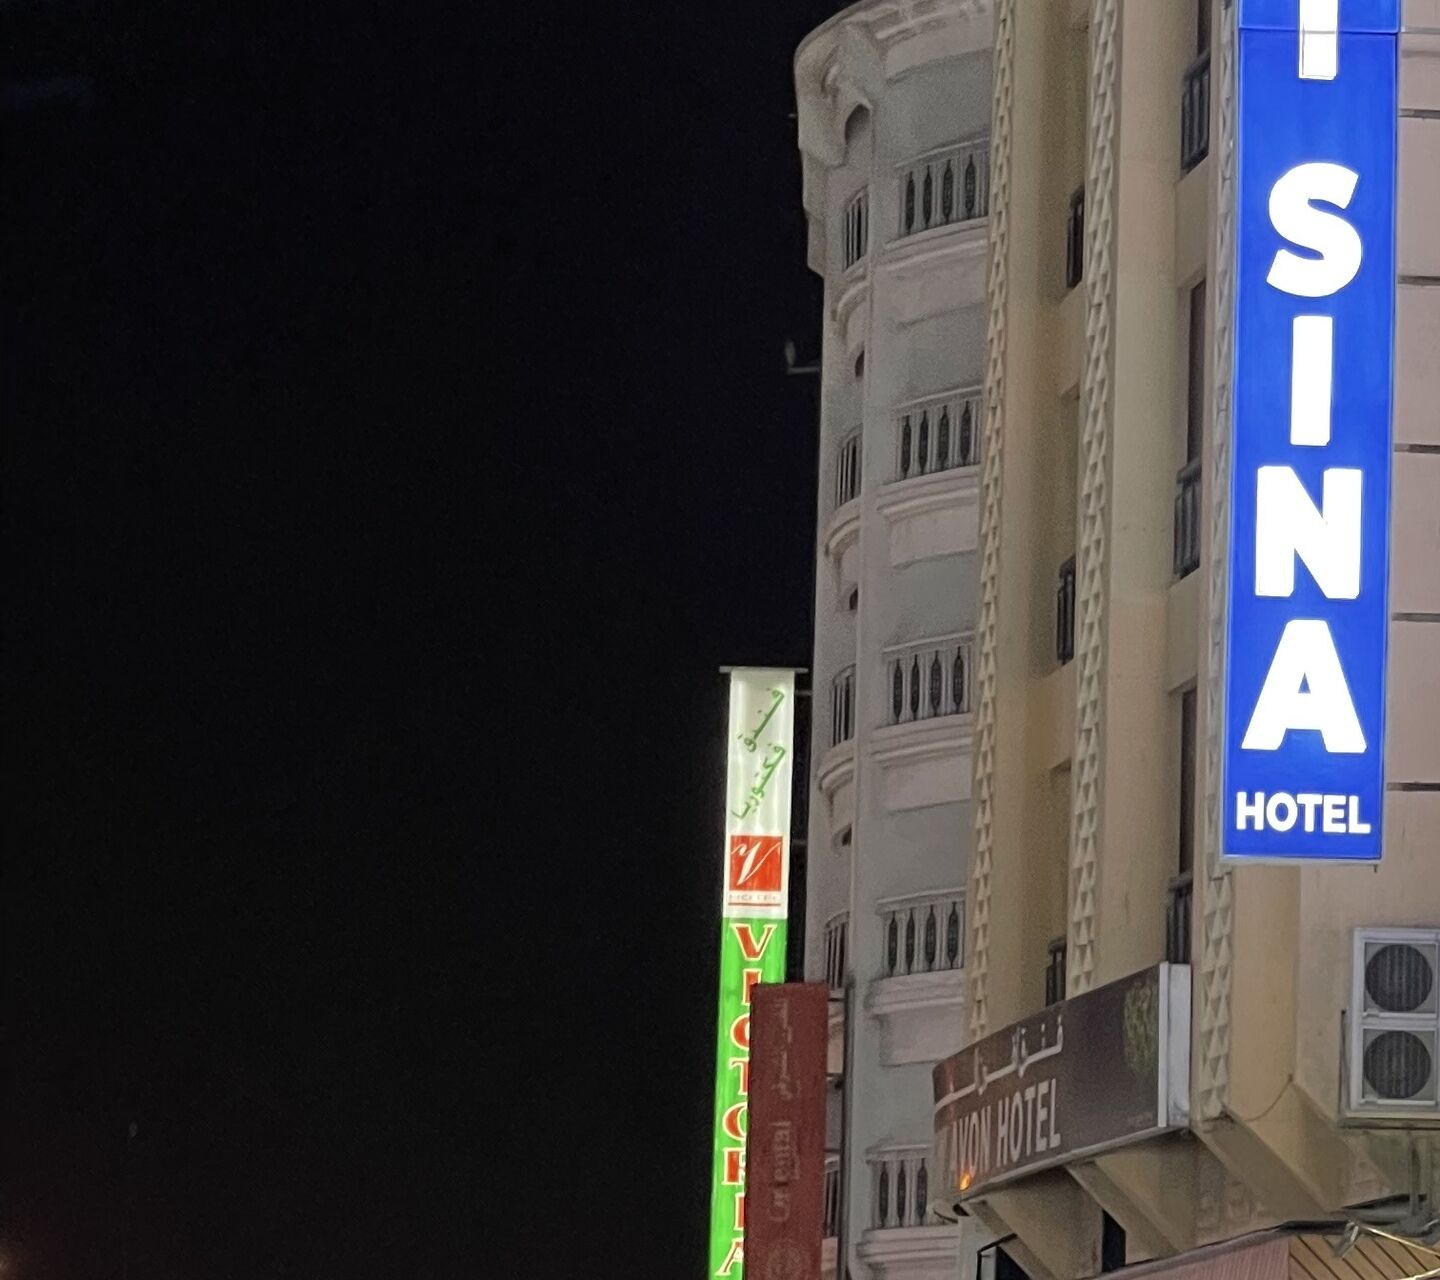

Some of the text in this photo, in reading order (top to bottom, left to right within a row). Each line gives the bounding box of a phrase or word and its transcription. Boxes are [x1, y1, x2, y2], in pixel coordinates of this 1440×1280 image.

[1240, 162, 1367, 754] SINA
[1235, 792, 1371, 834] HOTEL
[997, 1077, 1061, 1167] HOTEL
